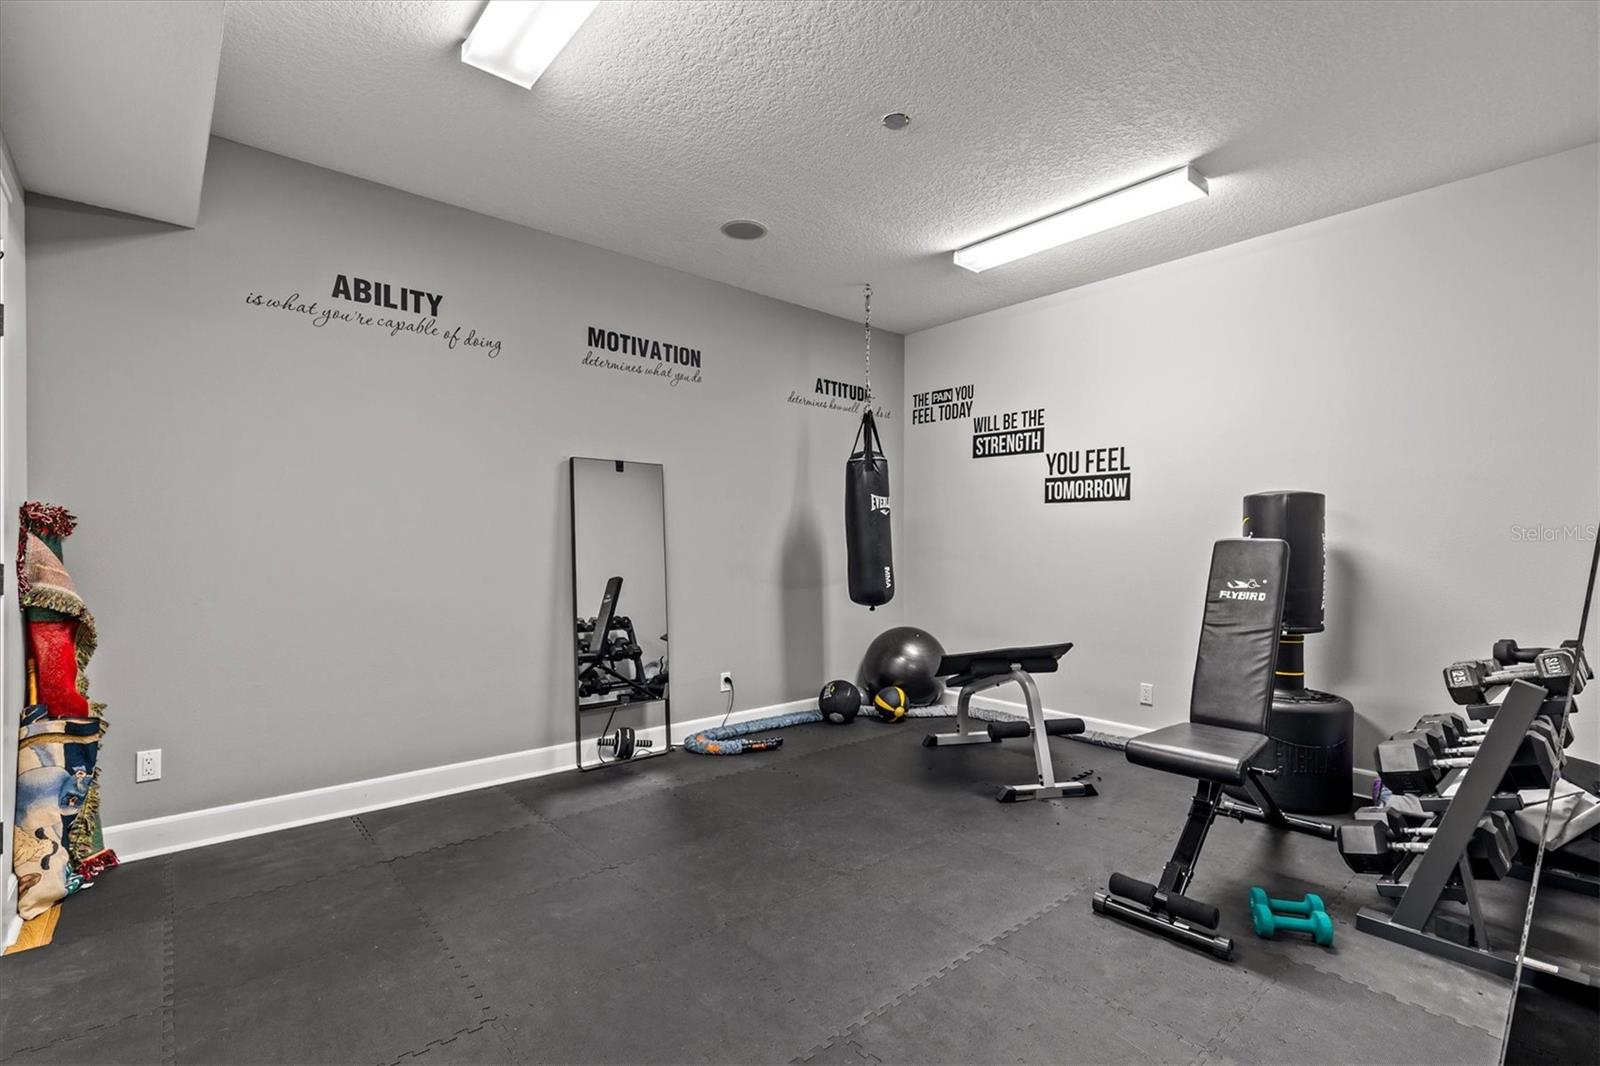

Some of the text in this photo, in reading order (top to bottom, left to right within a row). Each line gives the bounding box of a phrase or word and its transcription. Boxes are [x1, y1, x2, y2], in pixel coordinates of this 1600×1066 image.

[331, 274, 444, 317] ABILITY
[245, 291, 503, 358] is what you're capable of doing
[587, 326, 701, 369] MOTIVATION
[581, 350, 702, 387] determines what you do
[787, 390, 828, 409] determines
[828, 398, 842, 411] how
[842, 401, 861, 414] well
[912, 384, 975, 409] THE PAIN YOU
[912, 401, 974, 425] FEEL TODAY
[973, 408, 1046, 434] WILL BE THE
[975, 431, 1042, 457] STRENGTH
[1046, 446, 1131, 476] YOU FEEL
[1046, 477, 1129, 501] TOMORROW
[884, 566, 892, 589] MMA
[1219, 590, 1267, 602] FLYBIRD
[1452, 669, 1467, 684] 25
